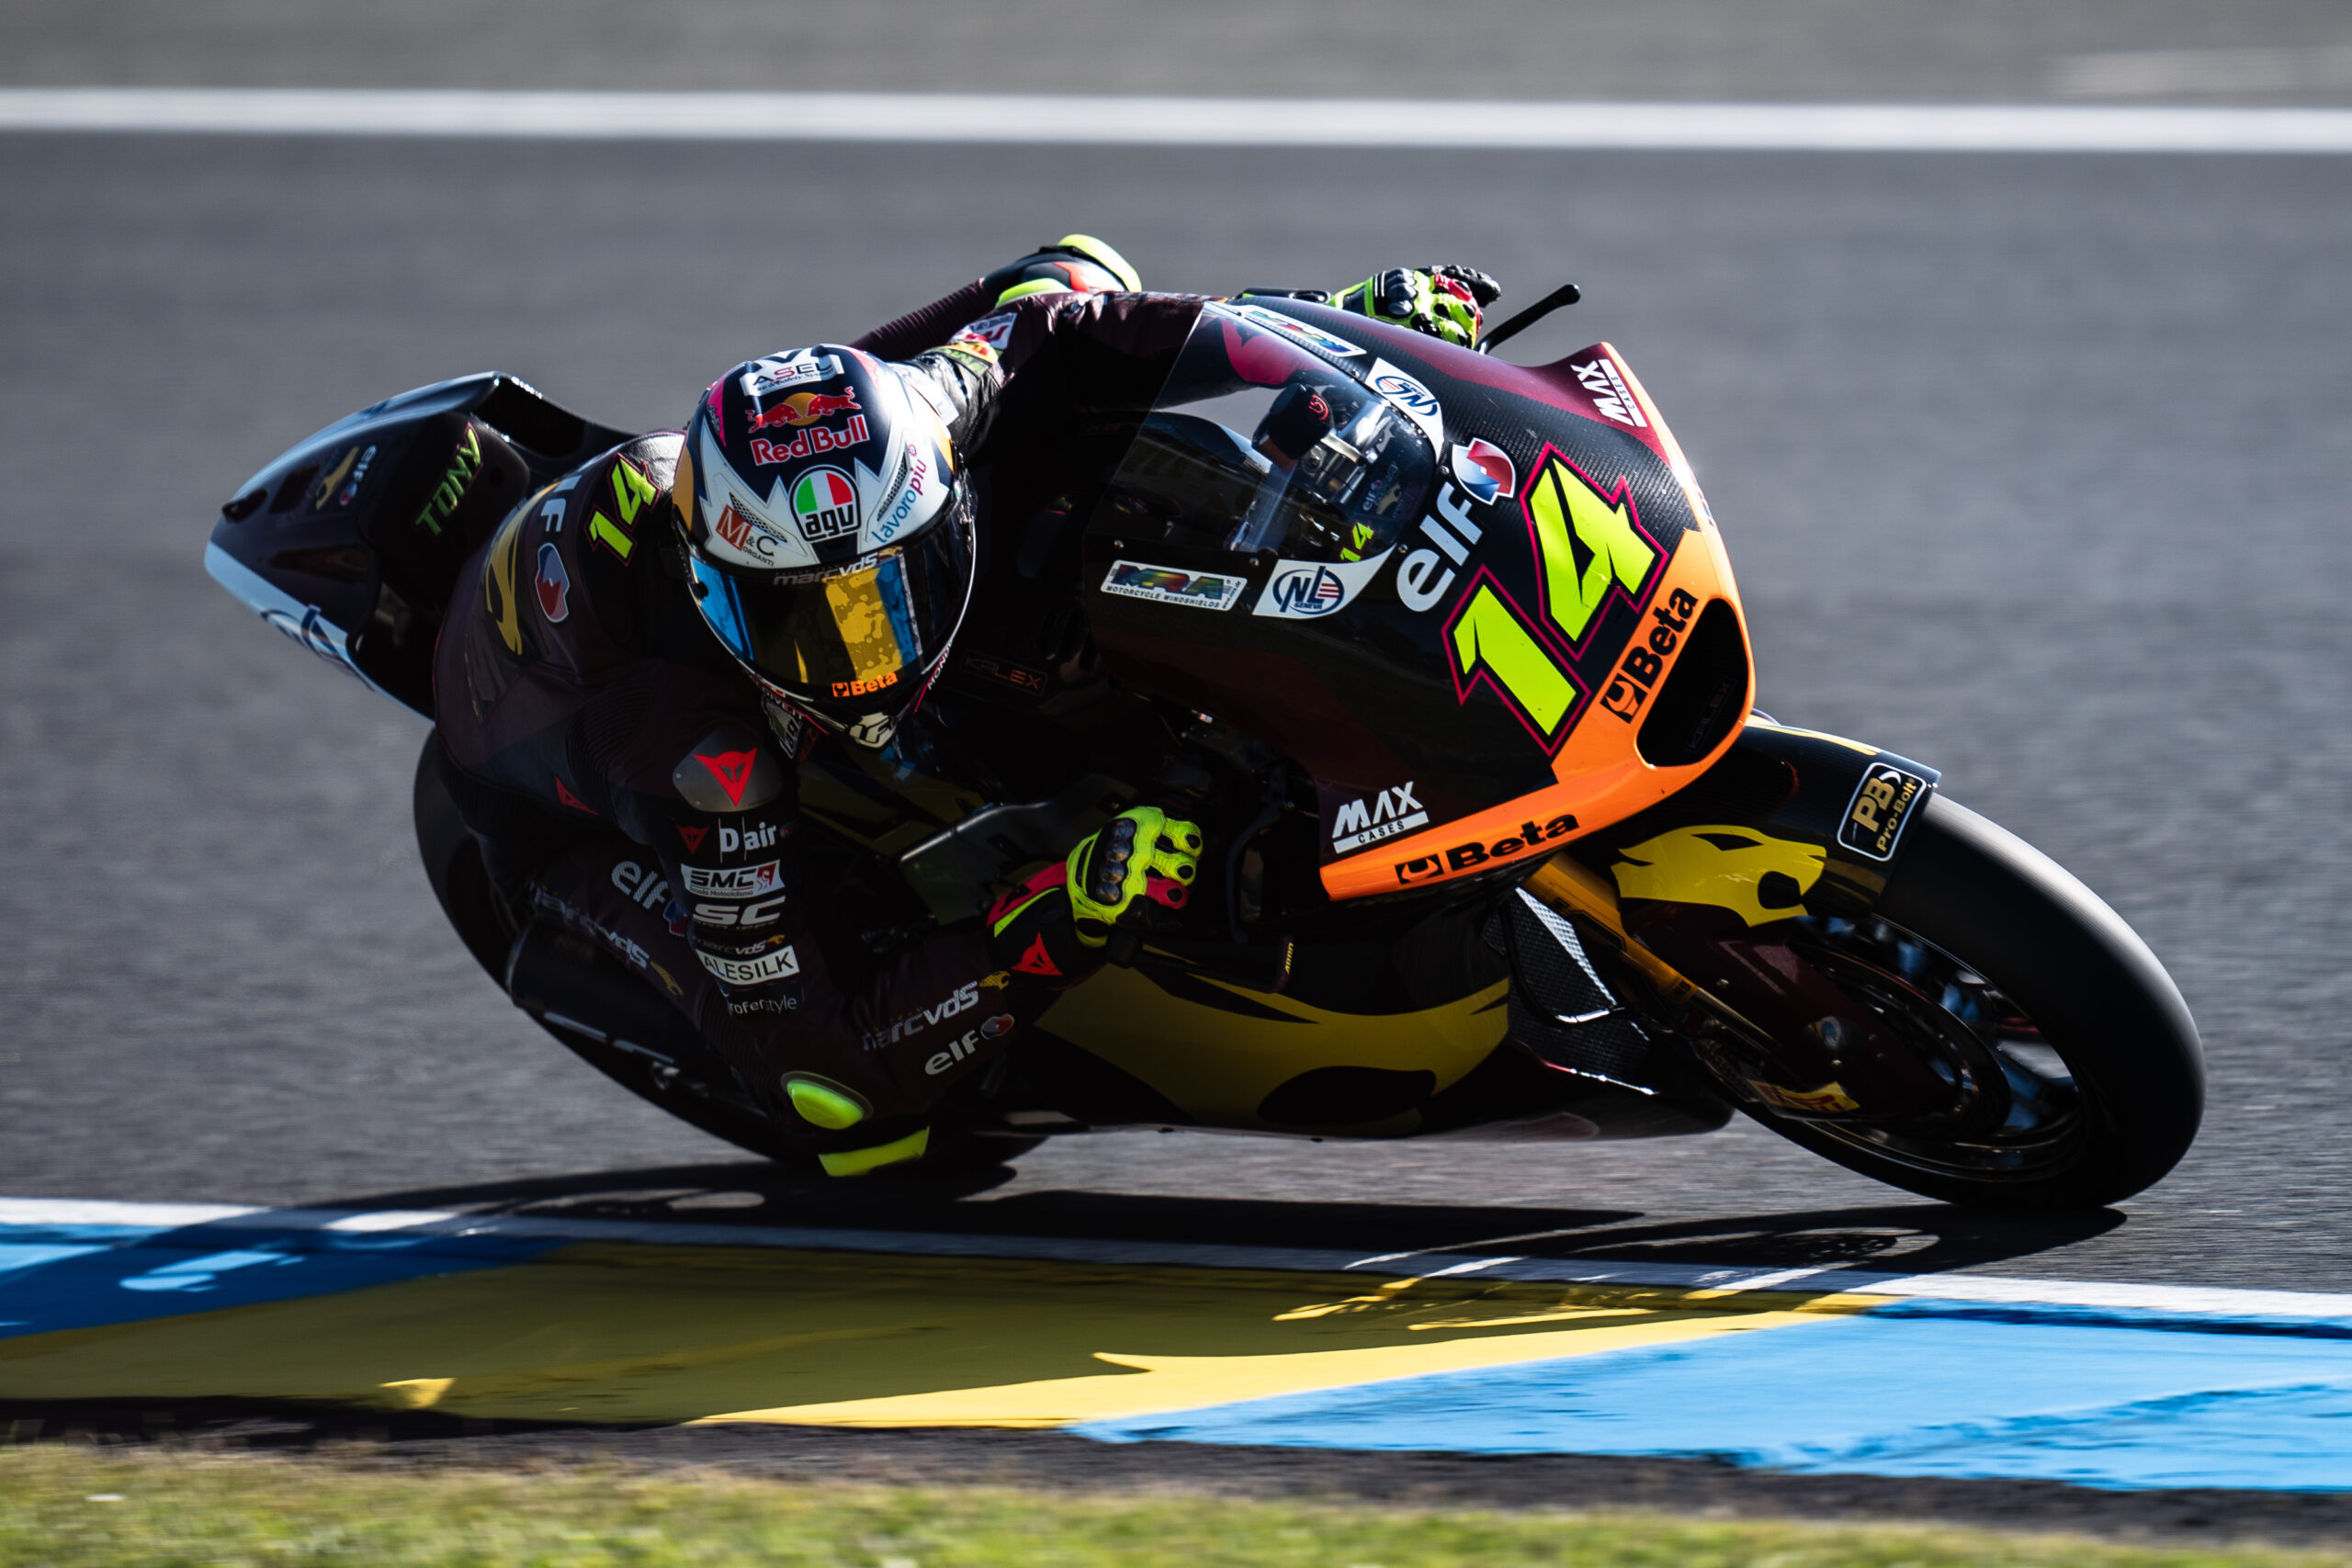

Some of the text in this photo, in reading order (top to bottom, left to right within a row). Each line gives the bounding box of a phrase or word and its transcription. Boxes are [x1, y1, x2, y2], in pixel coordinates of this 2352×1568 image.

[1570, 360, 1635, 426] MAX
[1611, 377, 1635, 409] CASES
[751, 414, 870, 466] Red Bull
[414, 427, 481, 536] TONY
[589, 457, 657, 559] 14
[806, 504, 854, 537] agv
[1340, 522, 1374, 563] 14
[1396, 482, 1484, 613] elf
[1106, 585, 1220, 608] MOTORCYCLE WINDSHIELDS
[1110, 564, 1226, 600] MRA
[1279, 566, 1325, 613] NL
[1453, 457, 1656, 737] 14
[1621, 588, 1699, 690] Beta
[850, 671, 899, 696] Beta
[1332, 781, 1424, 839] MAX
[1852, 777, 1895, 832] PB
[1357, 820, 1405, 844] CASES
[1445, 814, 1579, 872] Beta
[611, 860, 670, 910] elf
[690, 868, 757, 888] SMC
[692, 896, 786, 926] SC
[704, 951, 795, 981] ALESILK
[924, 1029, 979, 1077] elf
